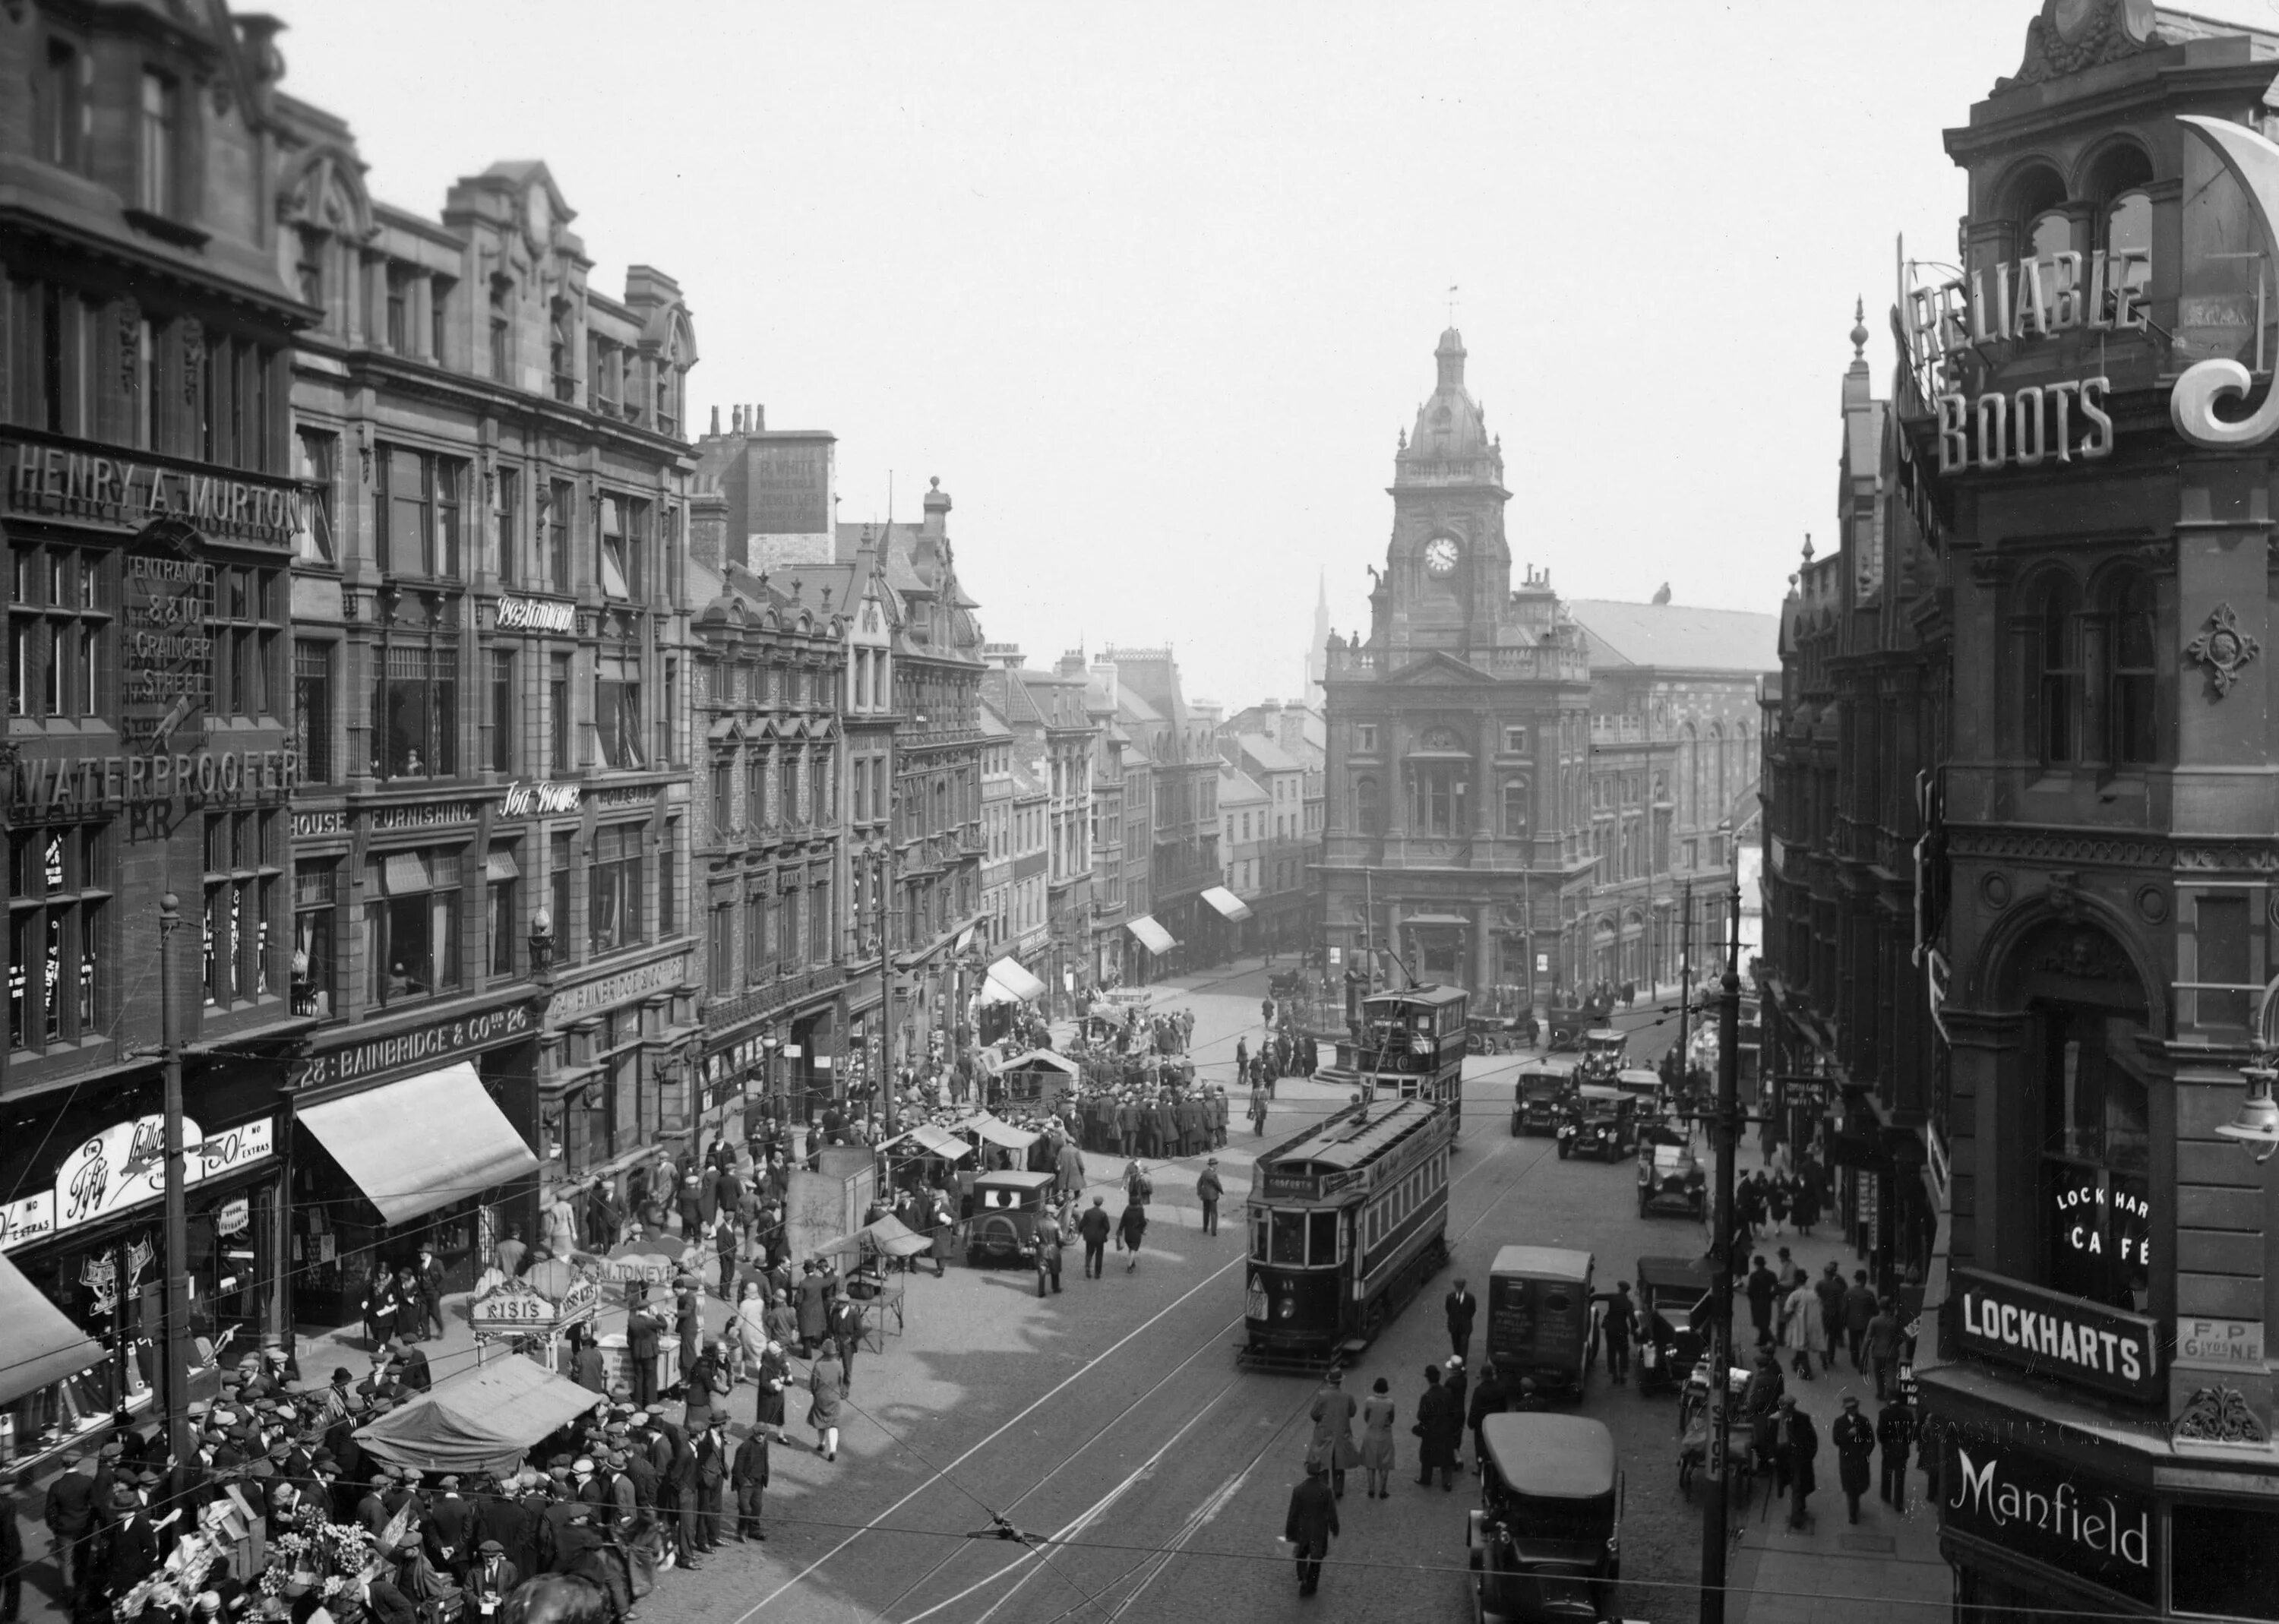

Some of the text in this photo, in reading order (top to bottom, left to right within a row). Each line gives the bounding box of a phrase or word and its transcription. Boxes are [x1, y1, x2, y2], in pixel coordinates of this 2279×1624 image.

[1907, 247, 2150, 370] RELIABLE
[1938, 376, 2113, 476] BOOTS
[18, 444, 135, 508] HENRY
[189, 475, 302, 533] MURTON
[134, 557, 213, 584] ENTRANCE
[150, 595, 200, 623] 8 & 10
[143, 669, 204, 695] STREET
[21, 751, 297, 806] WATERPROOFER
[291, 804, 471, 836] HOUSE FURNISHING
[577, 974, 637, 1011] BAINBRIDGE
[341, 1027, 449, 1078] BAINBRIDGE
[454, 1023, 463, 1046] &
[507, 1006, 526, 1033] 26
[242, 1144, 270, 1158] EXTRAS
[251, 1126, 262, 1135] NO
[13, 1221, 50, 1240] EXTRAS
[1964, 1294, 2141, 1382] LOCKHARTS
[1711, 1404, 1722, 1474] STOP
[1950, 1447, 2150, 1566] Manfield
